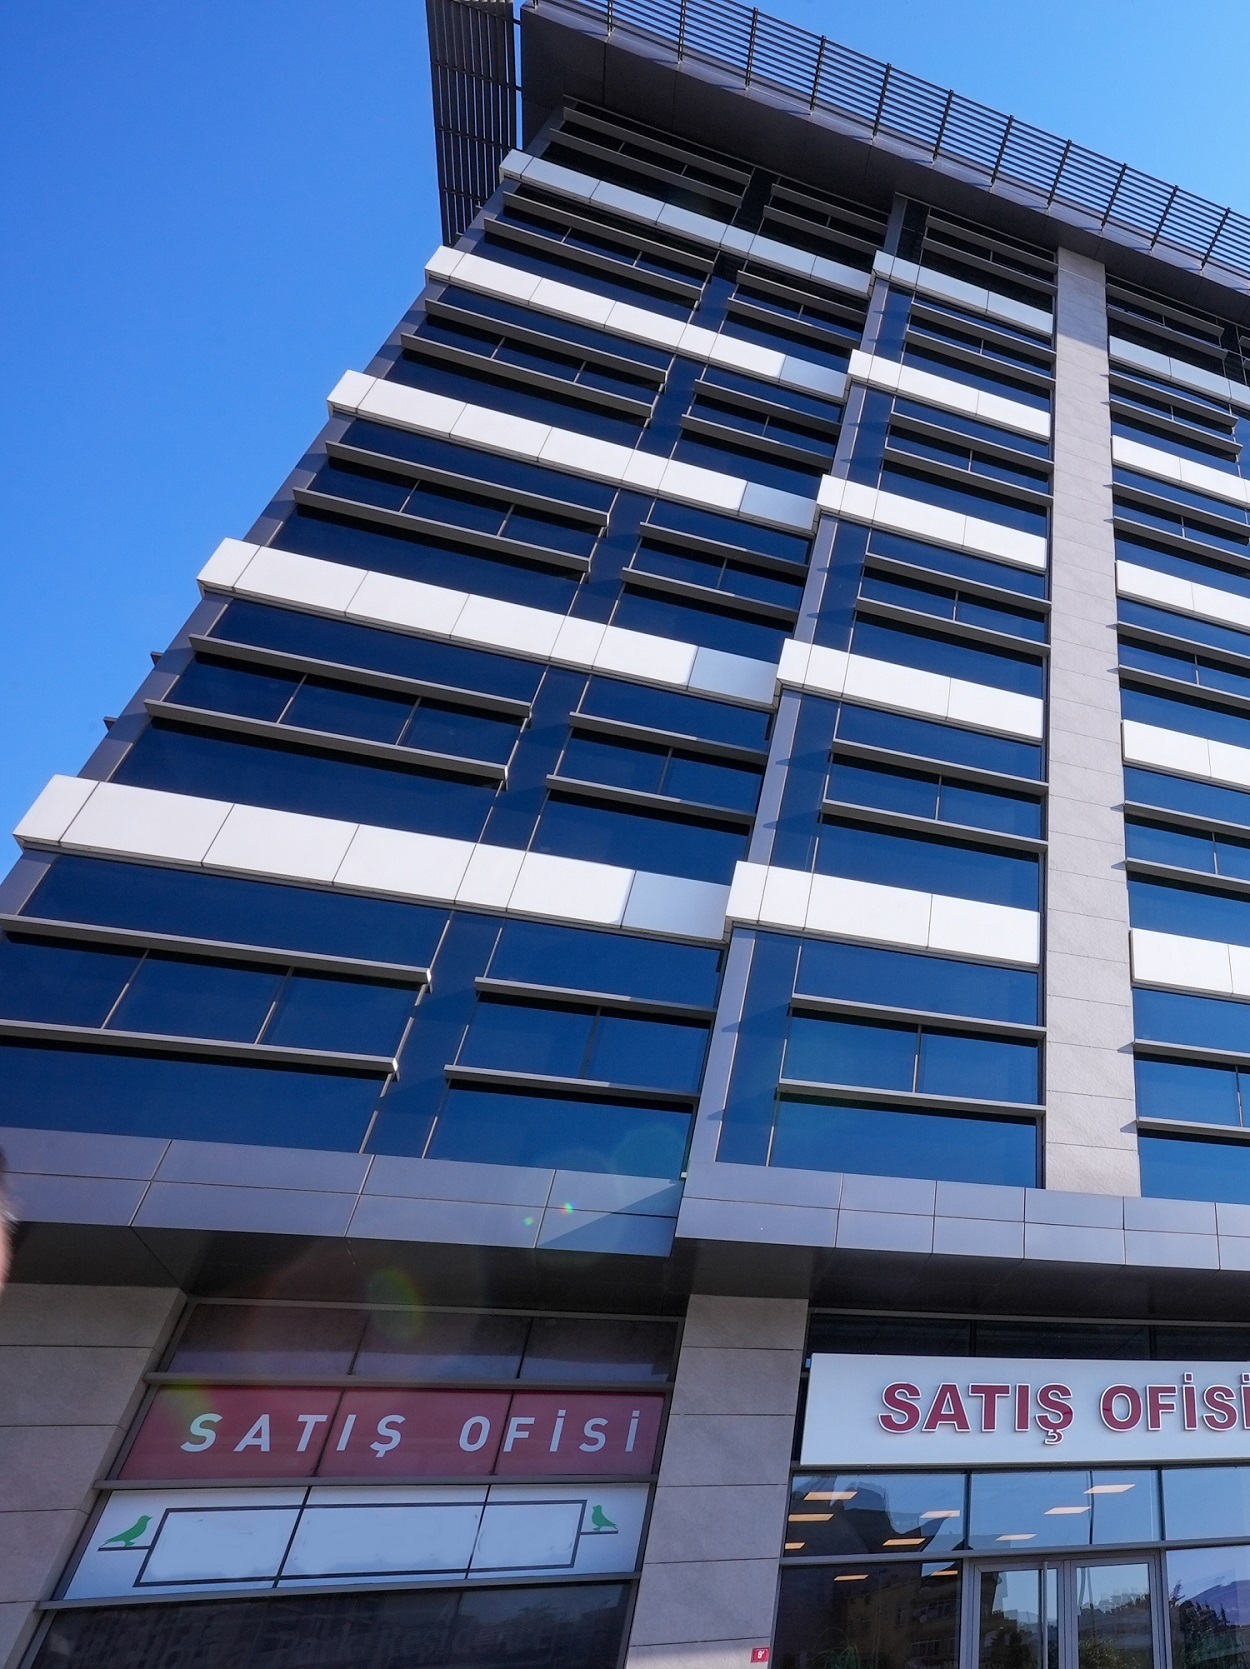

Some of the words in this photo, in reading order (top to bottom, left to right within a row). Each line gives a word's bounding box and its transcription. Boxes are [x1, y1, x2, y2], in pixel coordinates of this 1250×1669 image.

[180, 1413, 406, 1458] SATIŞ
[459, 1409, 641, 1452] OFİSİ
[878, 1380, 1075, 1446] SATIŞ
